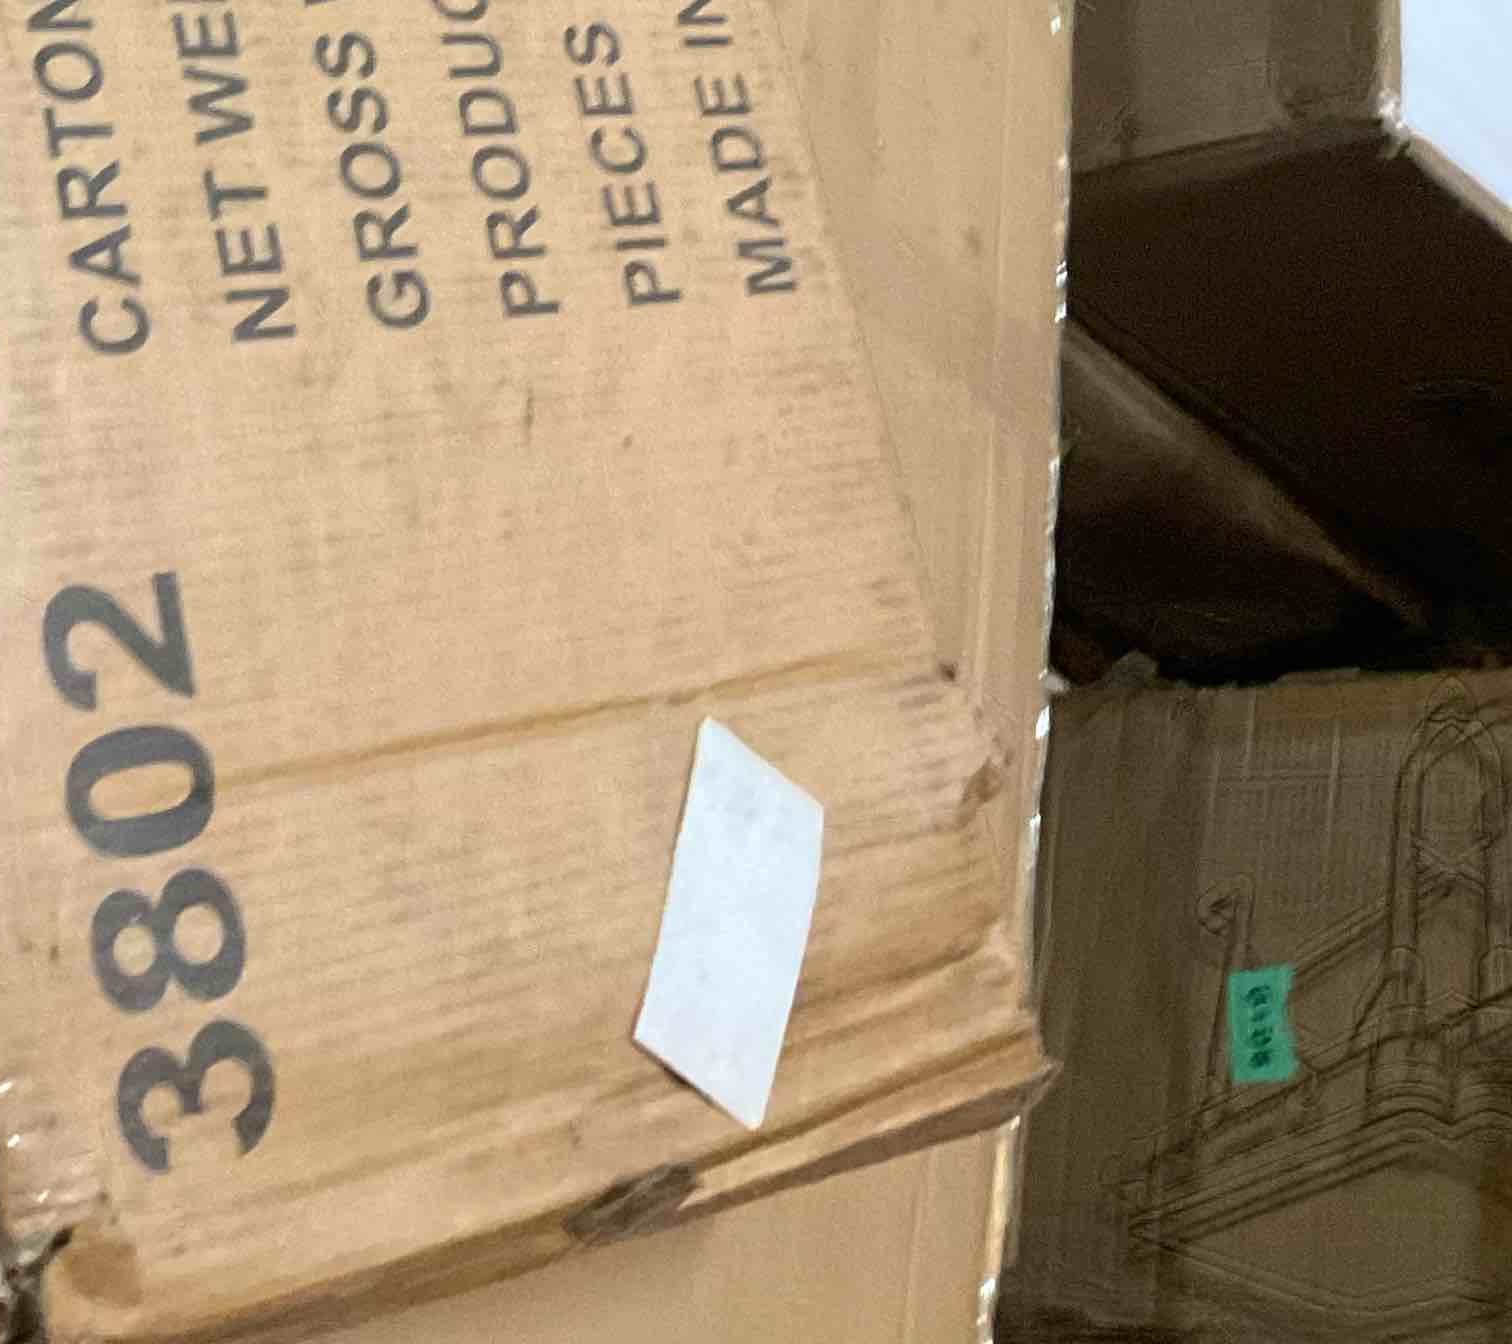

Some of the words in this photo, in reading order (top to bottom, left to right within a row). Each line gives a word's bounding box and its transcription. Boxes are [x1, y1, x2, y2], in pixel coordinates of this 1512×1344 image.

[205, 170, 297, 342] NET
[312, 31, 431, 329] GROSS
[565, 18, 681, 310] PIECES
[697, 74, 797, 298] MADE
[41, 570, 276, 1174] 3802
